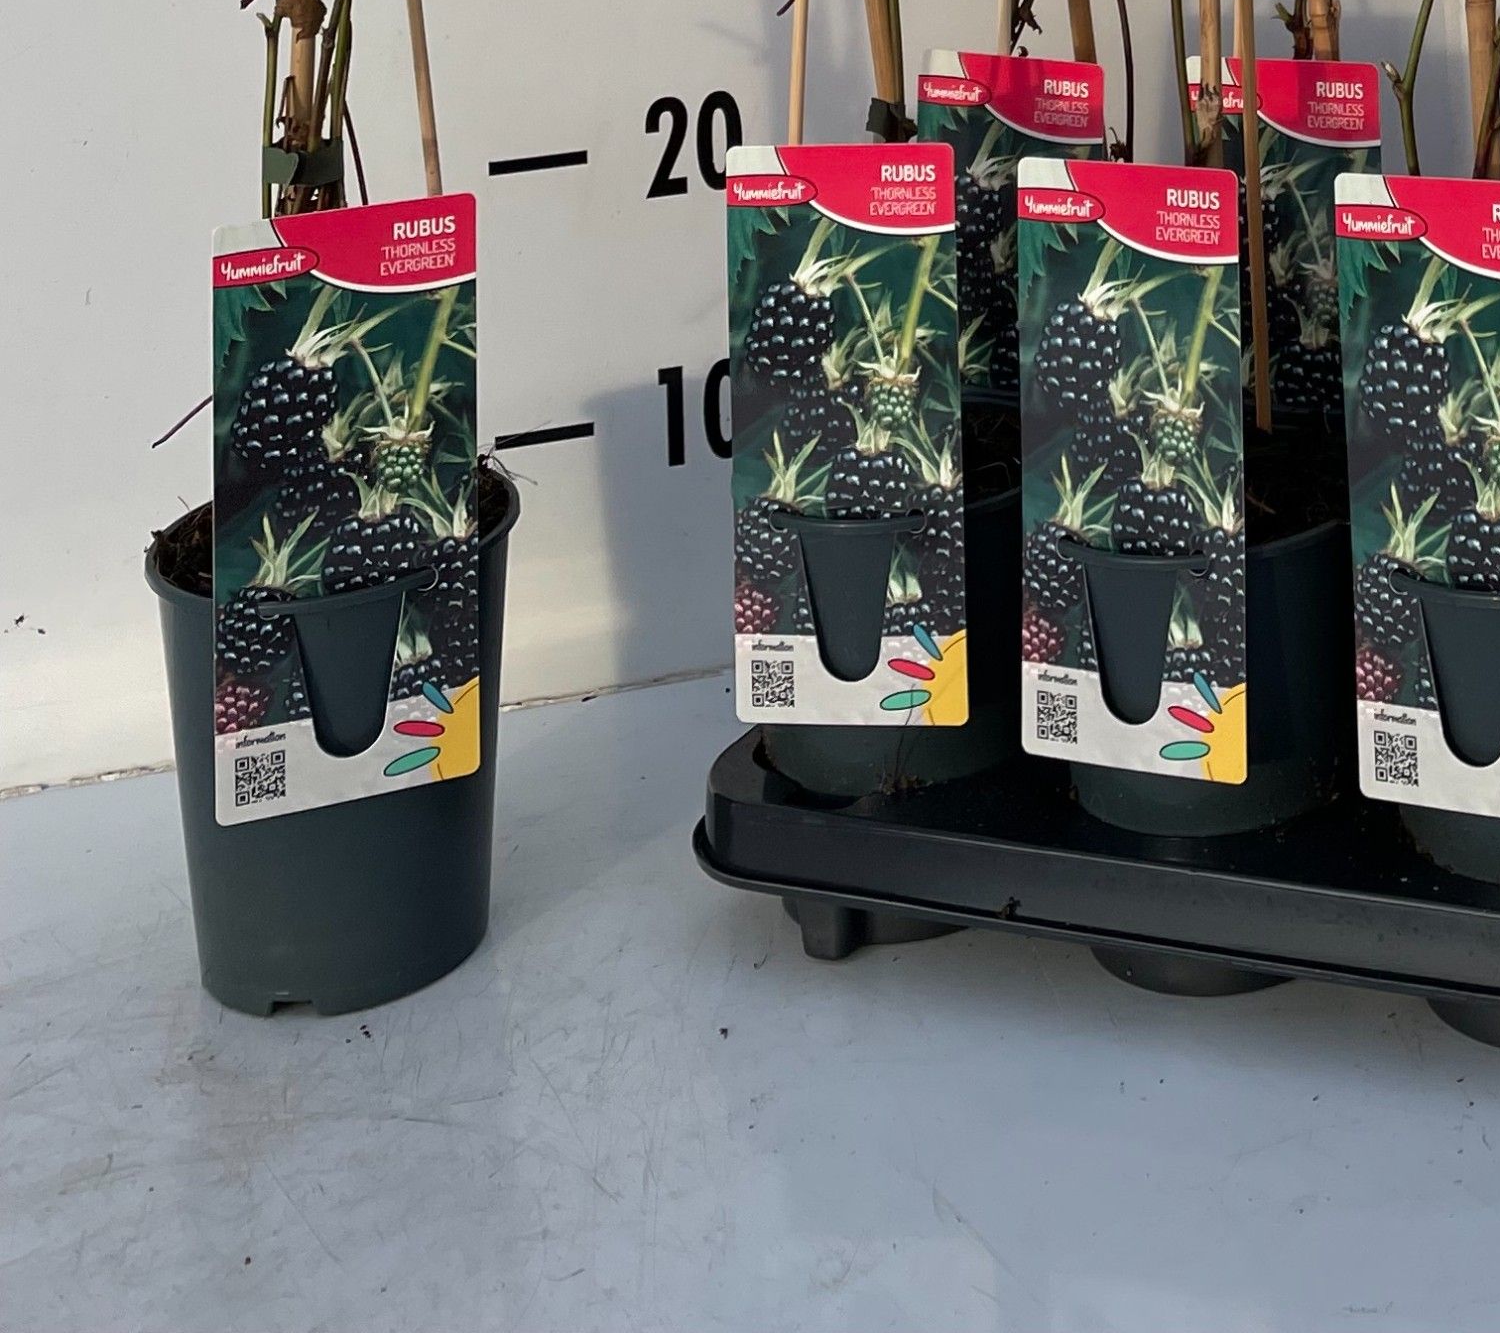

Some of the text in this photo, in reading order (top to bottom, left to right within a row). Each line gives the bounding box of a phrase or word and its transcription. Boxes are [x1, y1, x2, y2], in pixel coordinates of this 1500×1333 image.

[1044, 79, 1089, 98] RUBUS
[1316, 81, 1364, 99] RUBUS
[645, 90, 743, 199] 20
[881, 165, 936, 182] RUBUS
[732, 181, 805, 201] Yummiefruit
[1166, 188, 1220, 210] RUBUS
[1024, 195, 1094, 218] Yummiefruit
[393, 216, 456, 241] RUBUS
[1342, 213, 1415, 235] Yummiefruit
[220, 253, 305, 281] Yummiefruit
